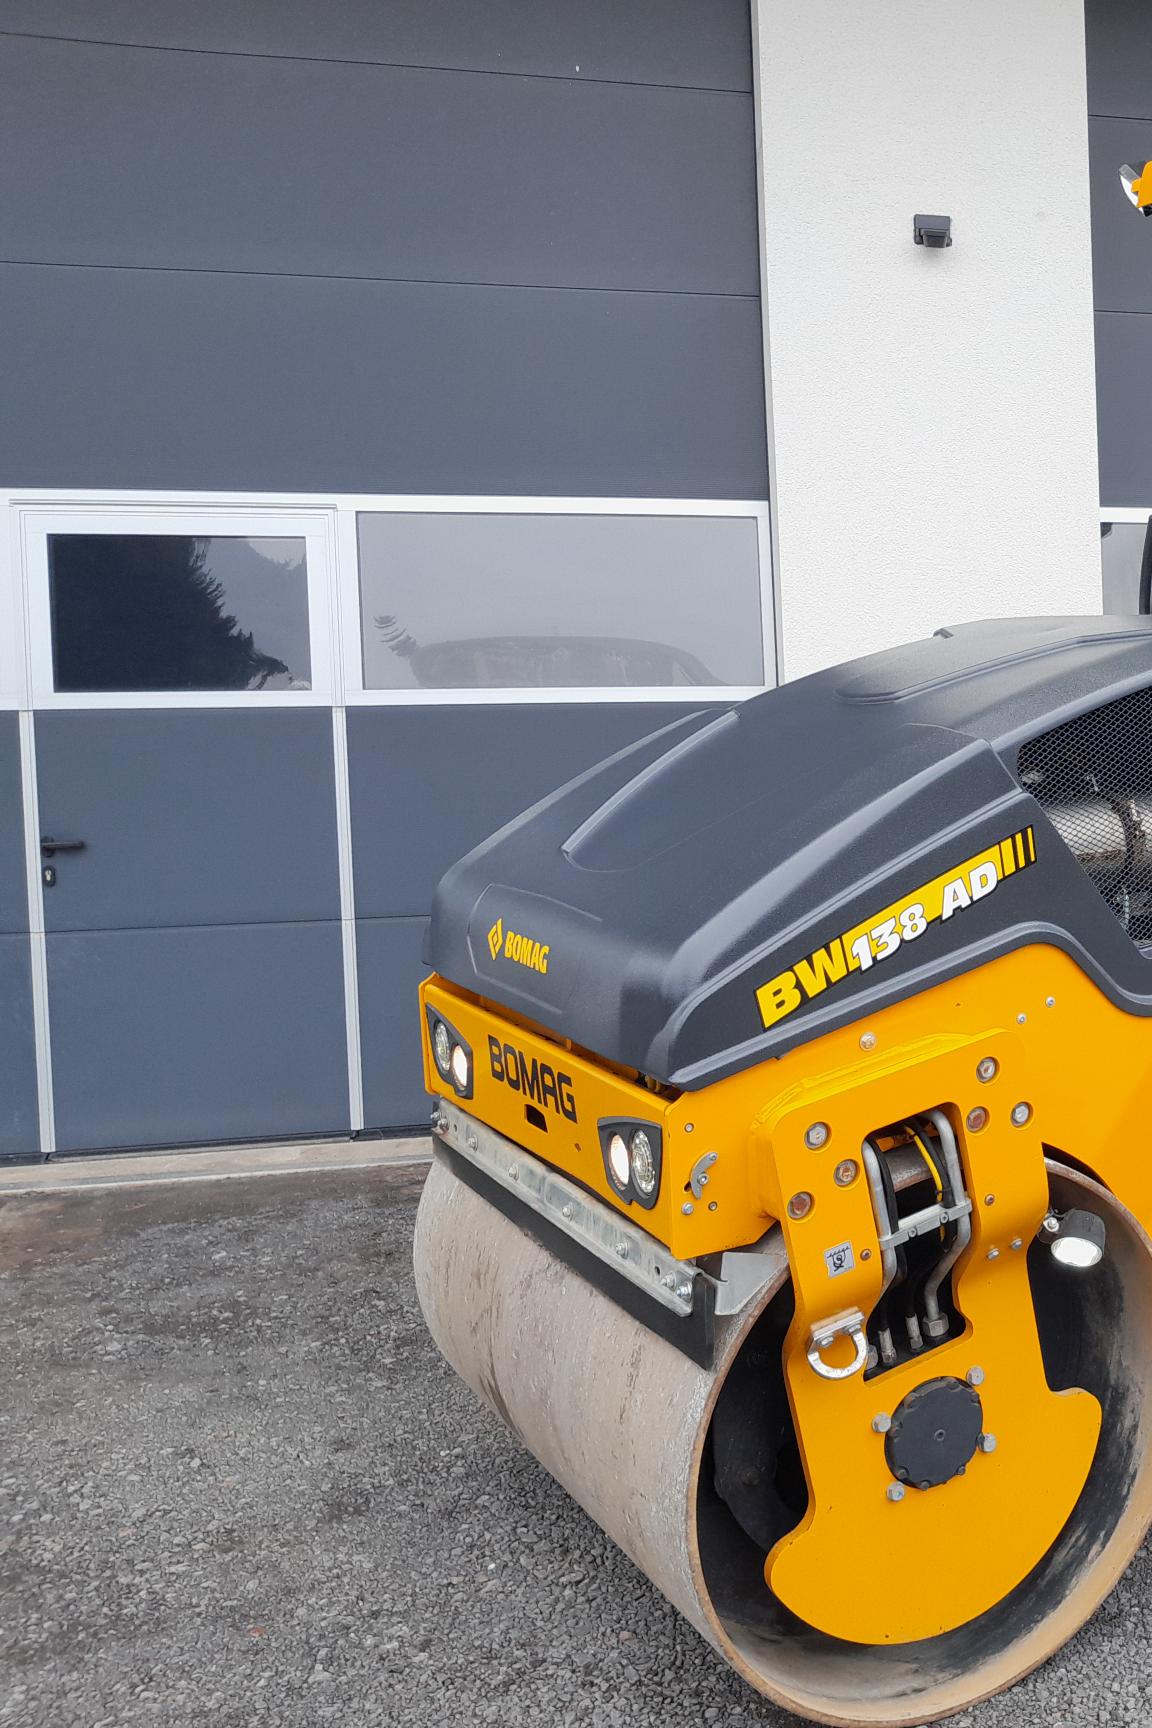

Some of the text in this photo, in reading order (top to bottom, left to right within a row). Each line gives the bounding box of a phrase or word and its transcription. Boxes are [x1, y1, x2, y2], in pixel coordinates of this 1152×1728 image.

[504, 931, 550, 974] BOMAG
[755, 860, 999, 1029] BW 138 AD
[488, 1034, 577, 1124] BOMAG
